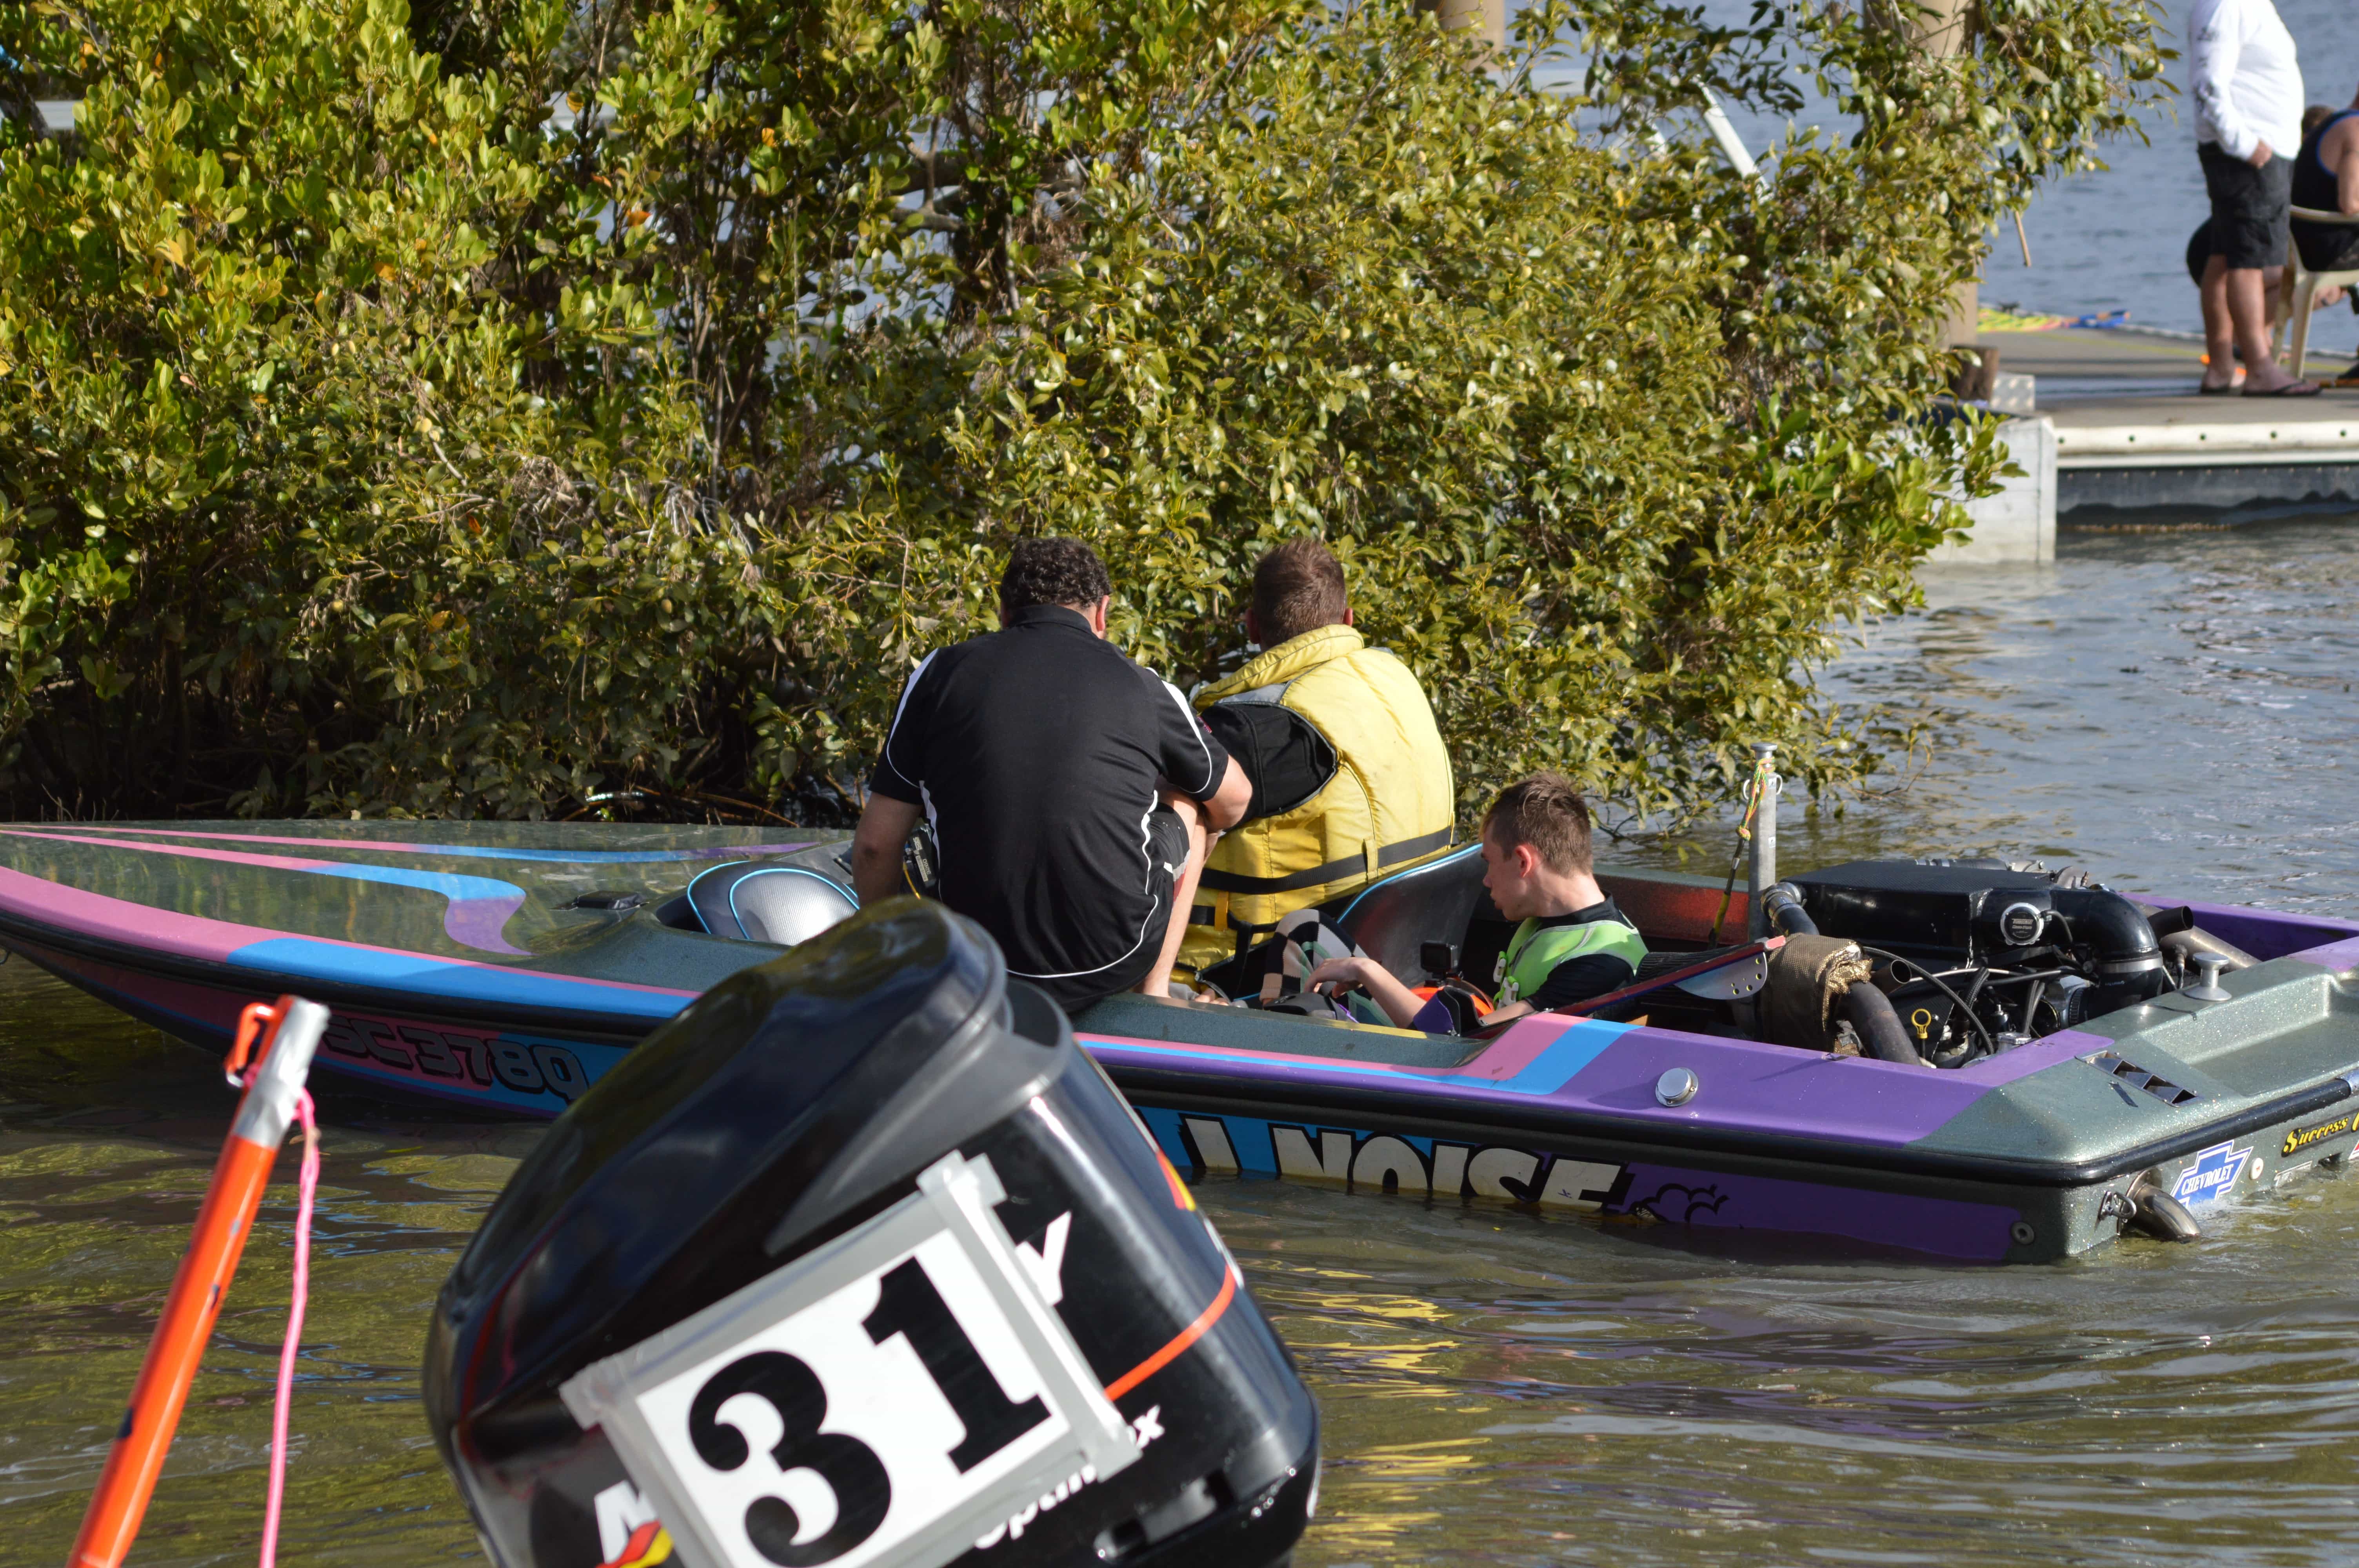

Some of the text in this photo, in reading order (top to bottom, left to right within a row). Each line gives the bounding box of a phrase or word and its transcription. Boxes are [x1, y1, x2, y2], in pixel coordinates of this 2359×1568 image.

[2281, 1117, 2349, 1157] Success
[2181, 1163, 2234, 1196] CHEVROLET
[689, 1256, 1052, 1565] 31
